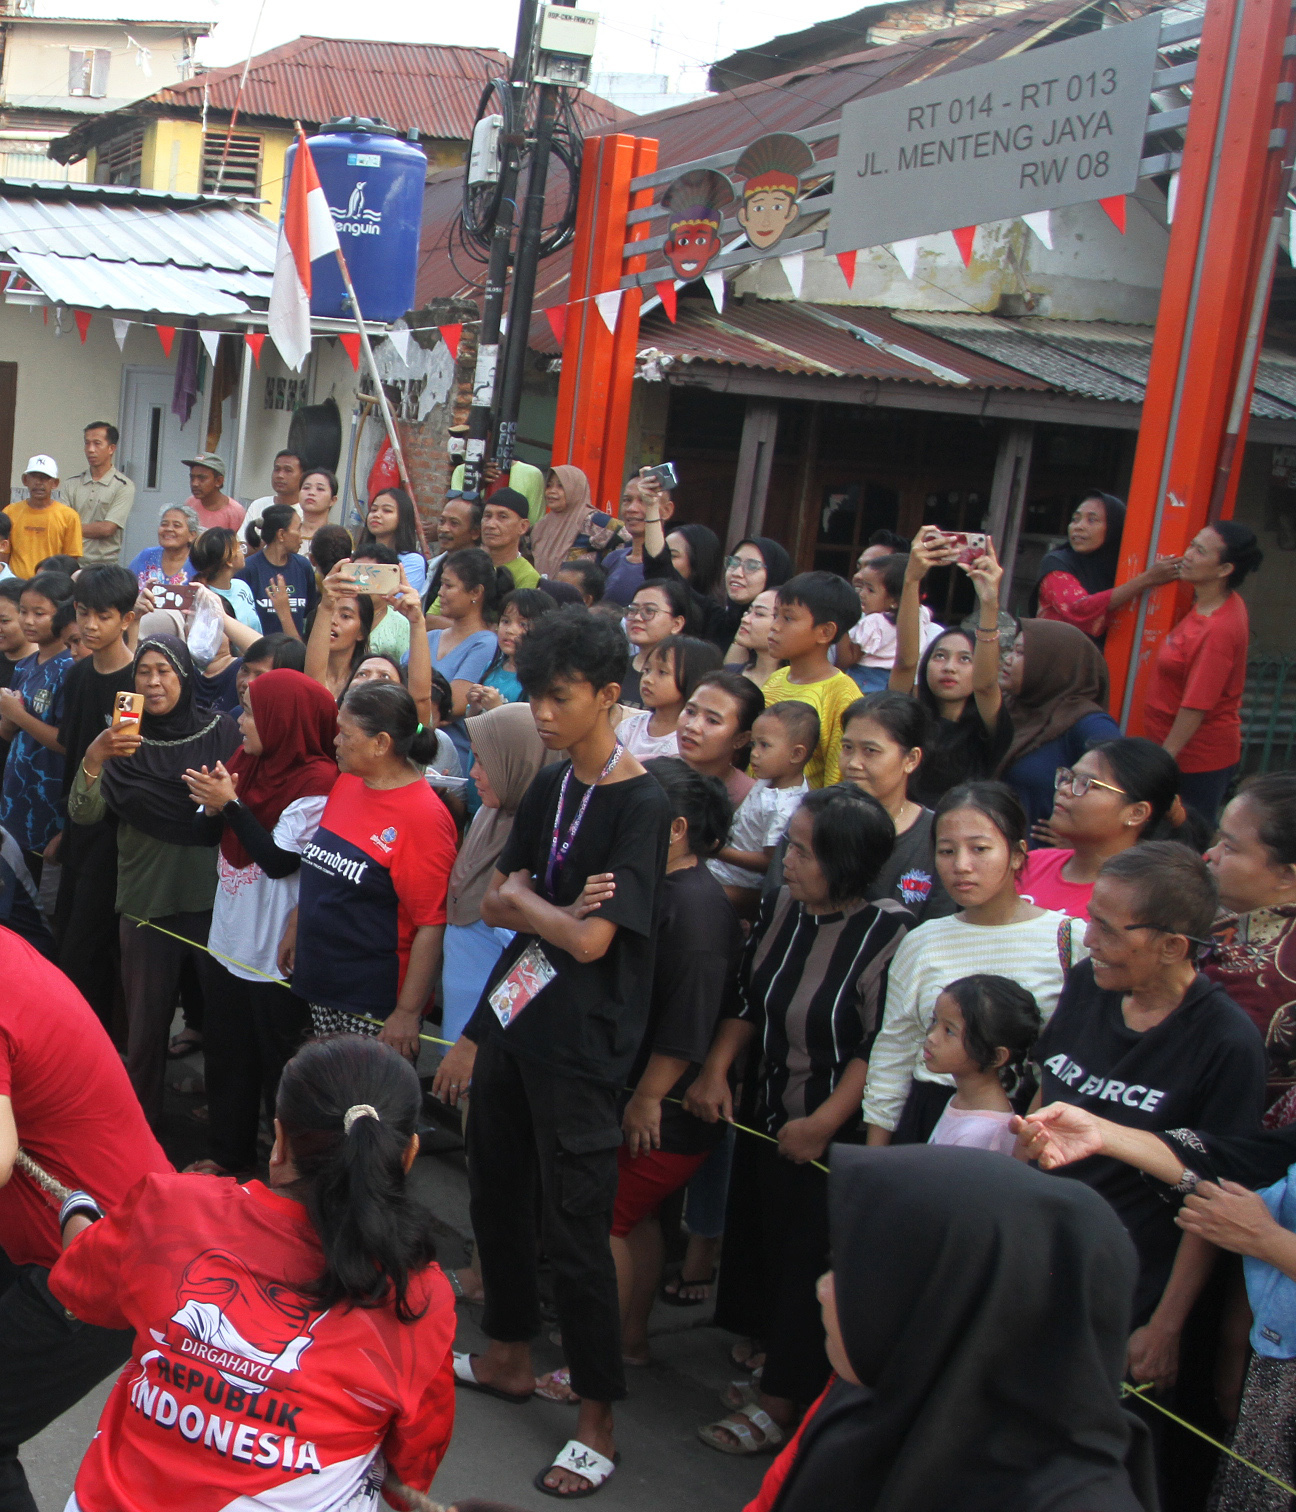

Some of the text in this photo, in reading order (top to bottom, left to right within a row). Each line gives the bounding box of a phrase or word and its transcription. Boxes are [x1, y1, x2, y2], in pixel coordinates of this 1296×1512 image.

[907, 102, 942, 132] RT
[949, 92, 993, 124] 014
[1021, 79, 1059, 111] RT
[1066, 68, 1117, 101] 013
[857, 110, 1113, 178] JL. MENTENG JAYA
[1020, 150, 1110, 189] RW 08
[334, 221, 380, 237] enguin
[302, 841, 369, 885] ependent
[1044, 1053, 1083, 1087] AIR
[181, 1338, 274, 1382] DIRGAHAYU
[157, 1356, 303, 1433] REPUBLIK
[131, 1377, 321, 1475] INDONESIA
